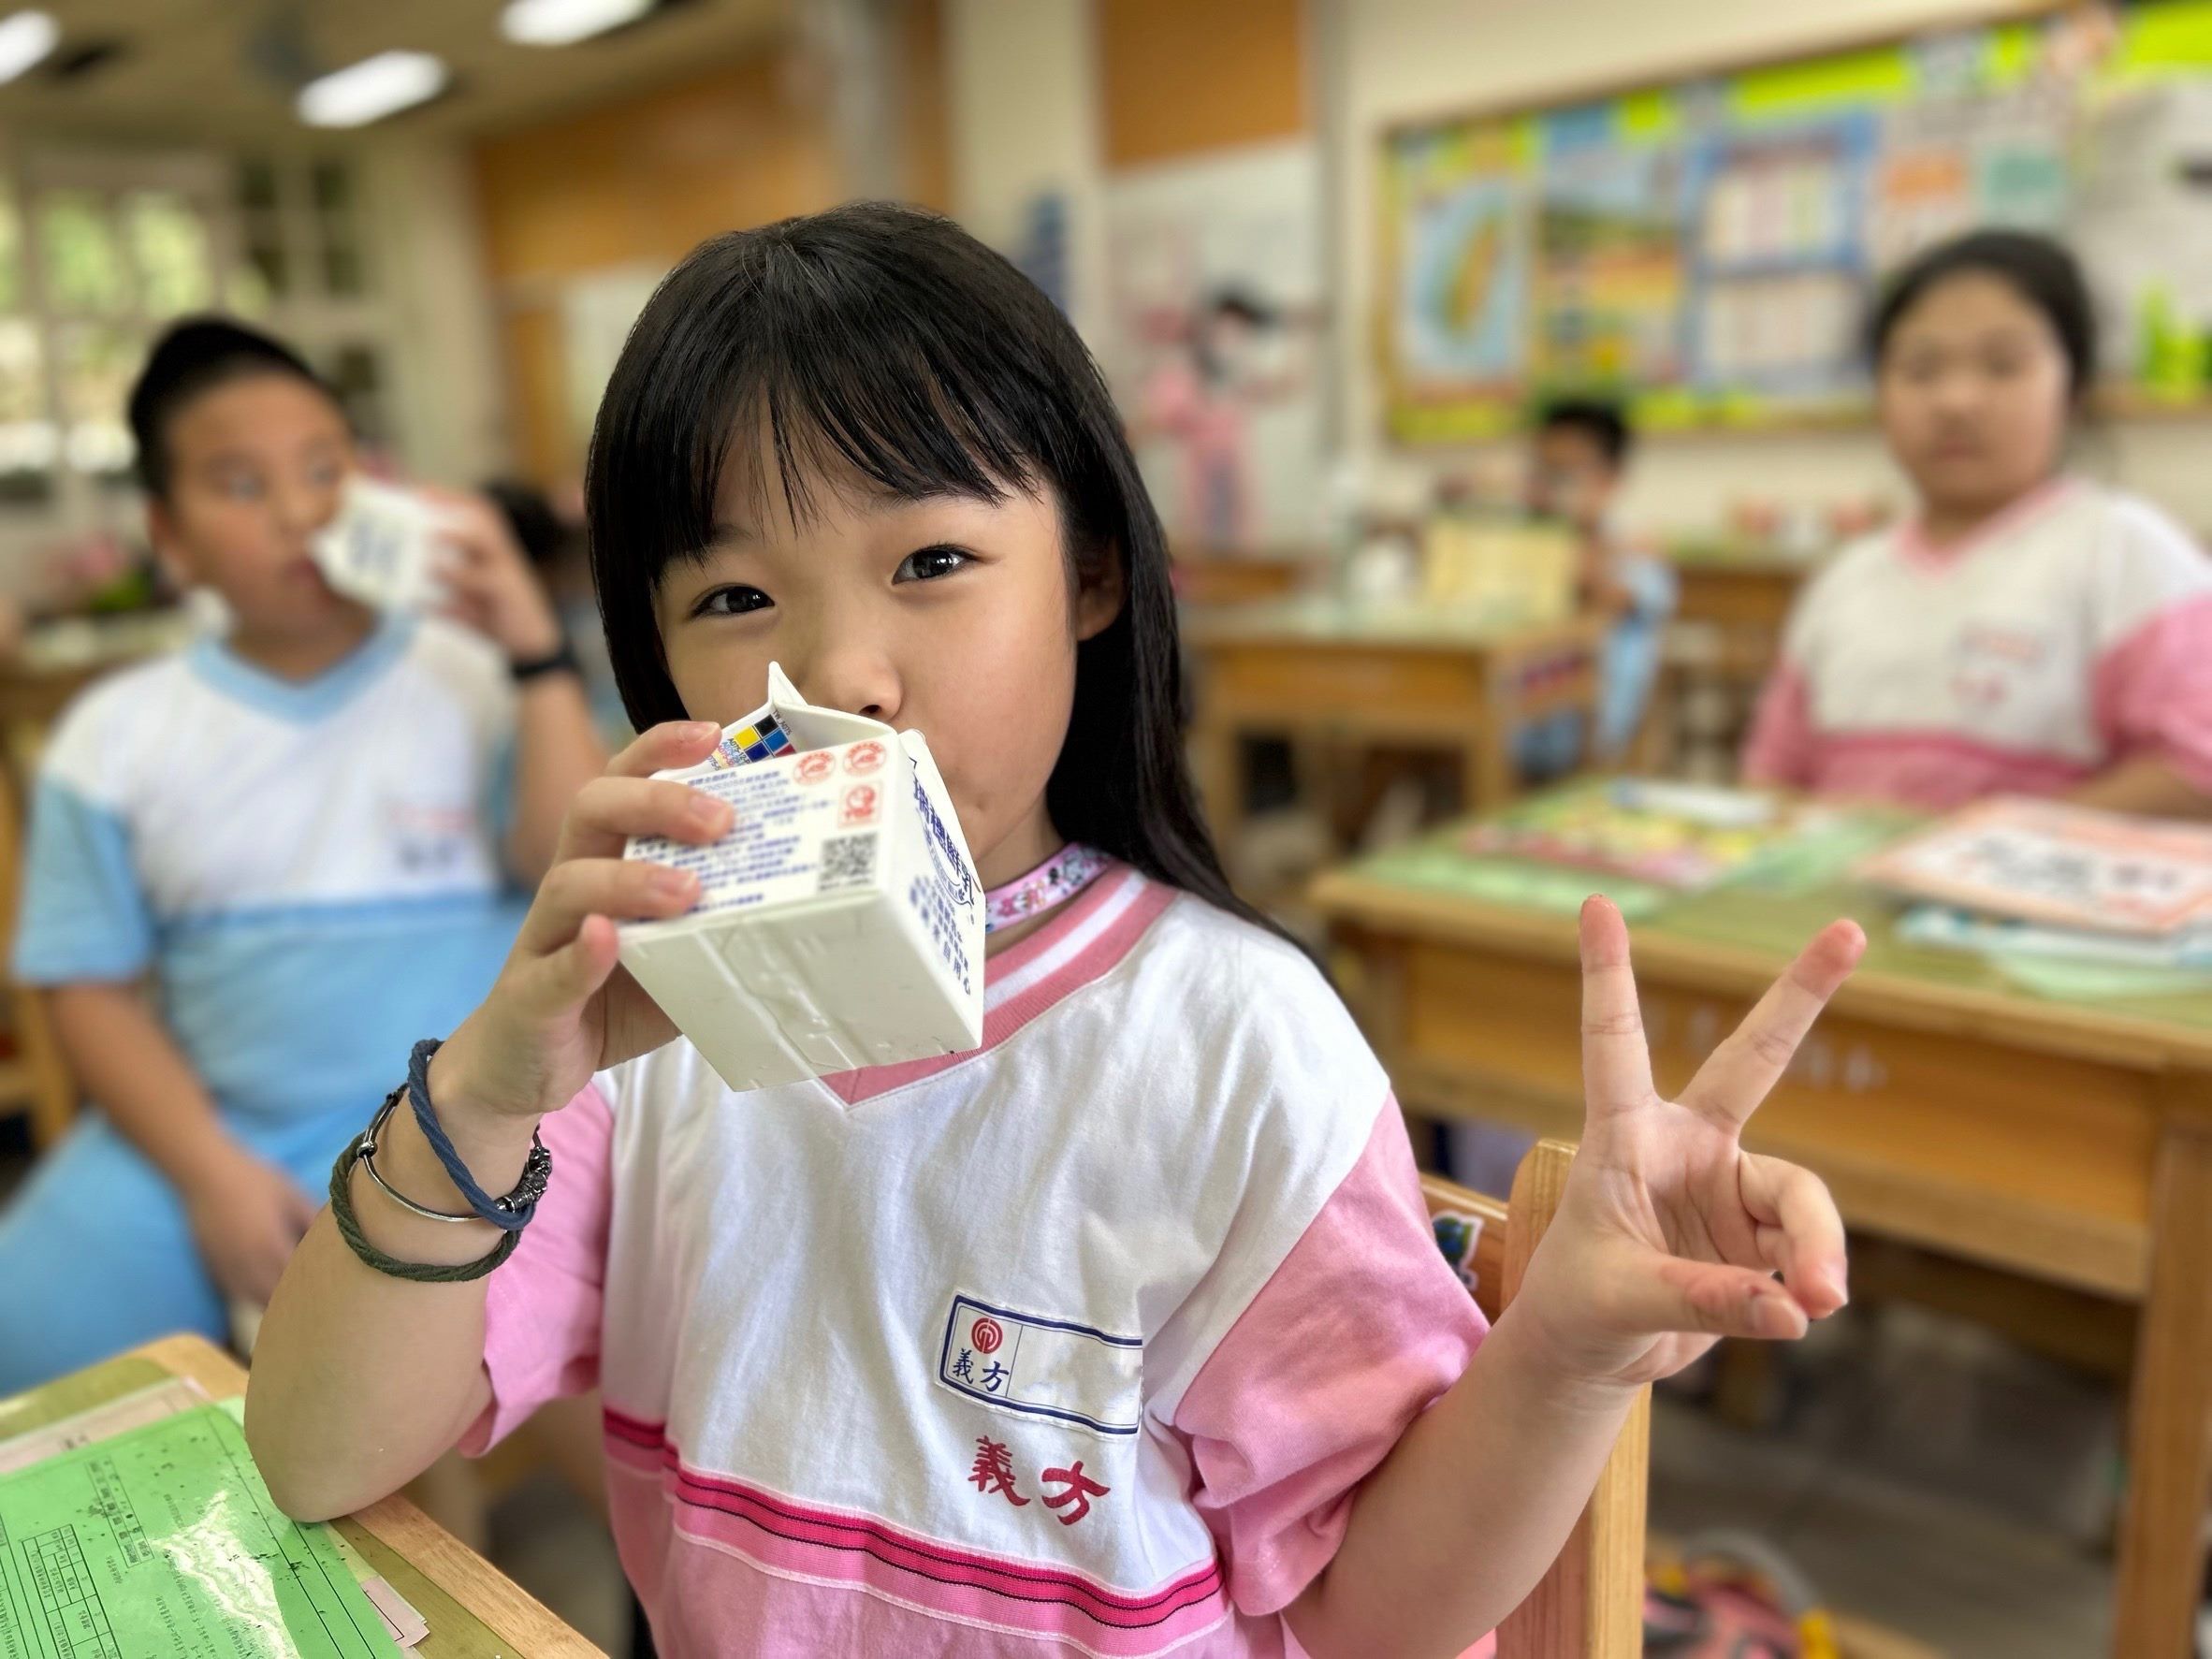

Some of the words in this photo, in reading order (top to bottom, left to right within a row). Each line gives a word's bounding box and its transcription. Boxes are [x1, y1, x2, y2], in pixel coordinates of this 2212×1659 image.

[912, 771, 974, 905] 瑞穗鮮乳
[953, 1347, 1010, 1391] 義方
[968, 1435, 1112, 1526] 義方
